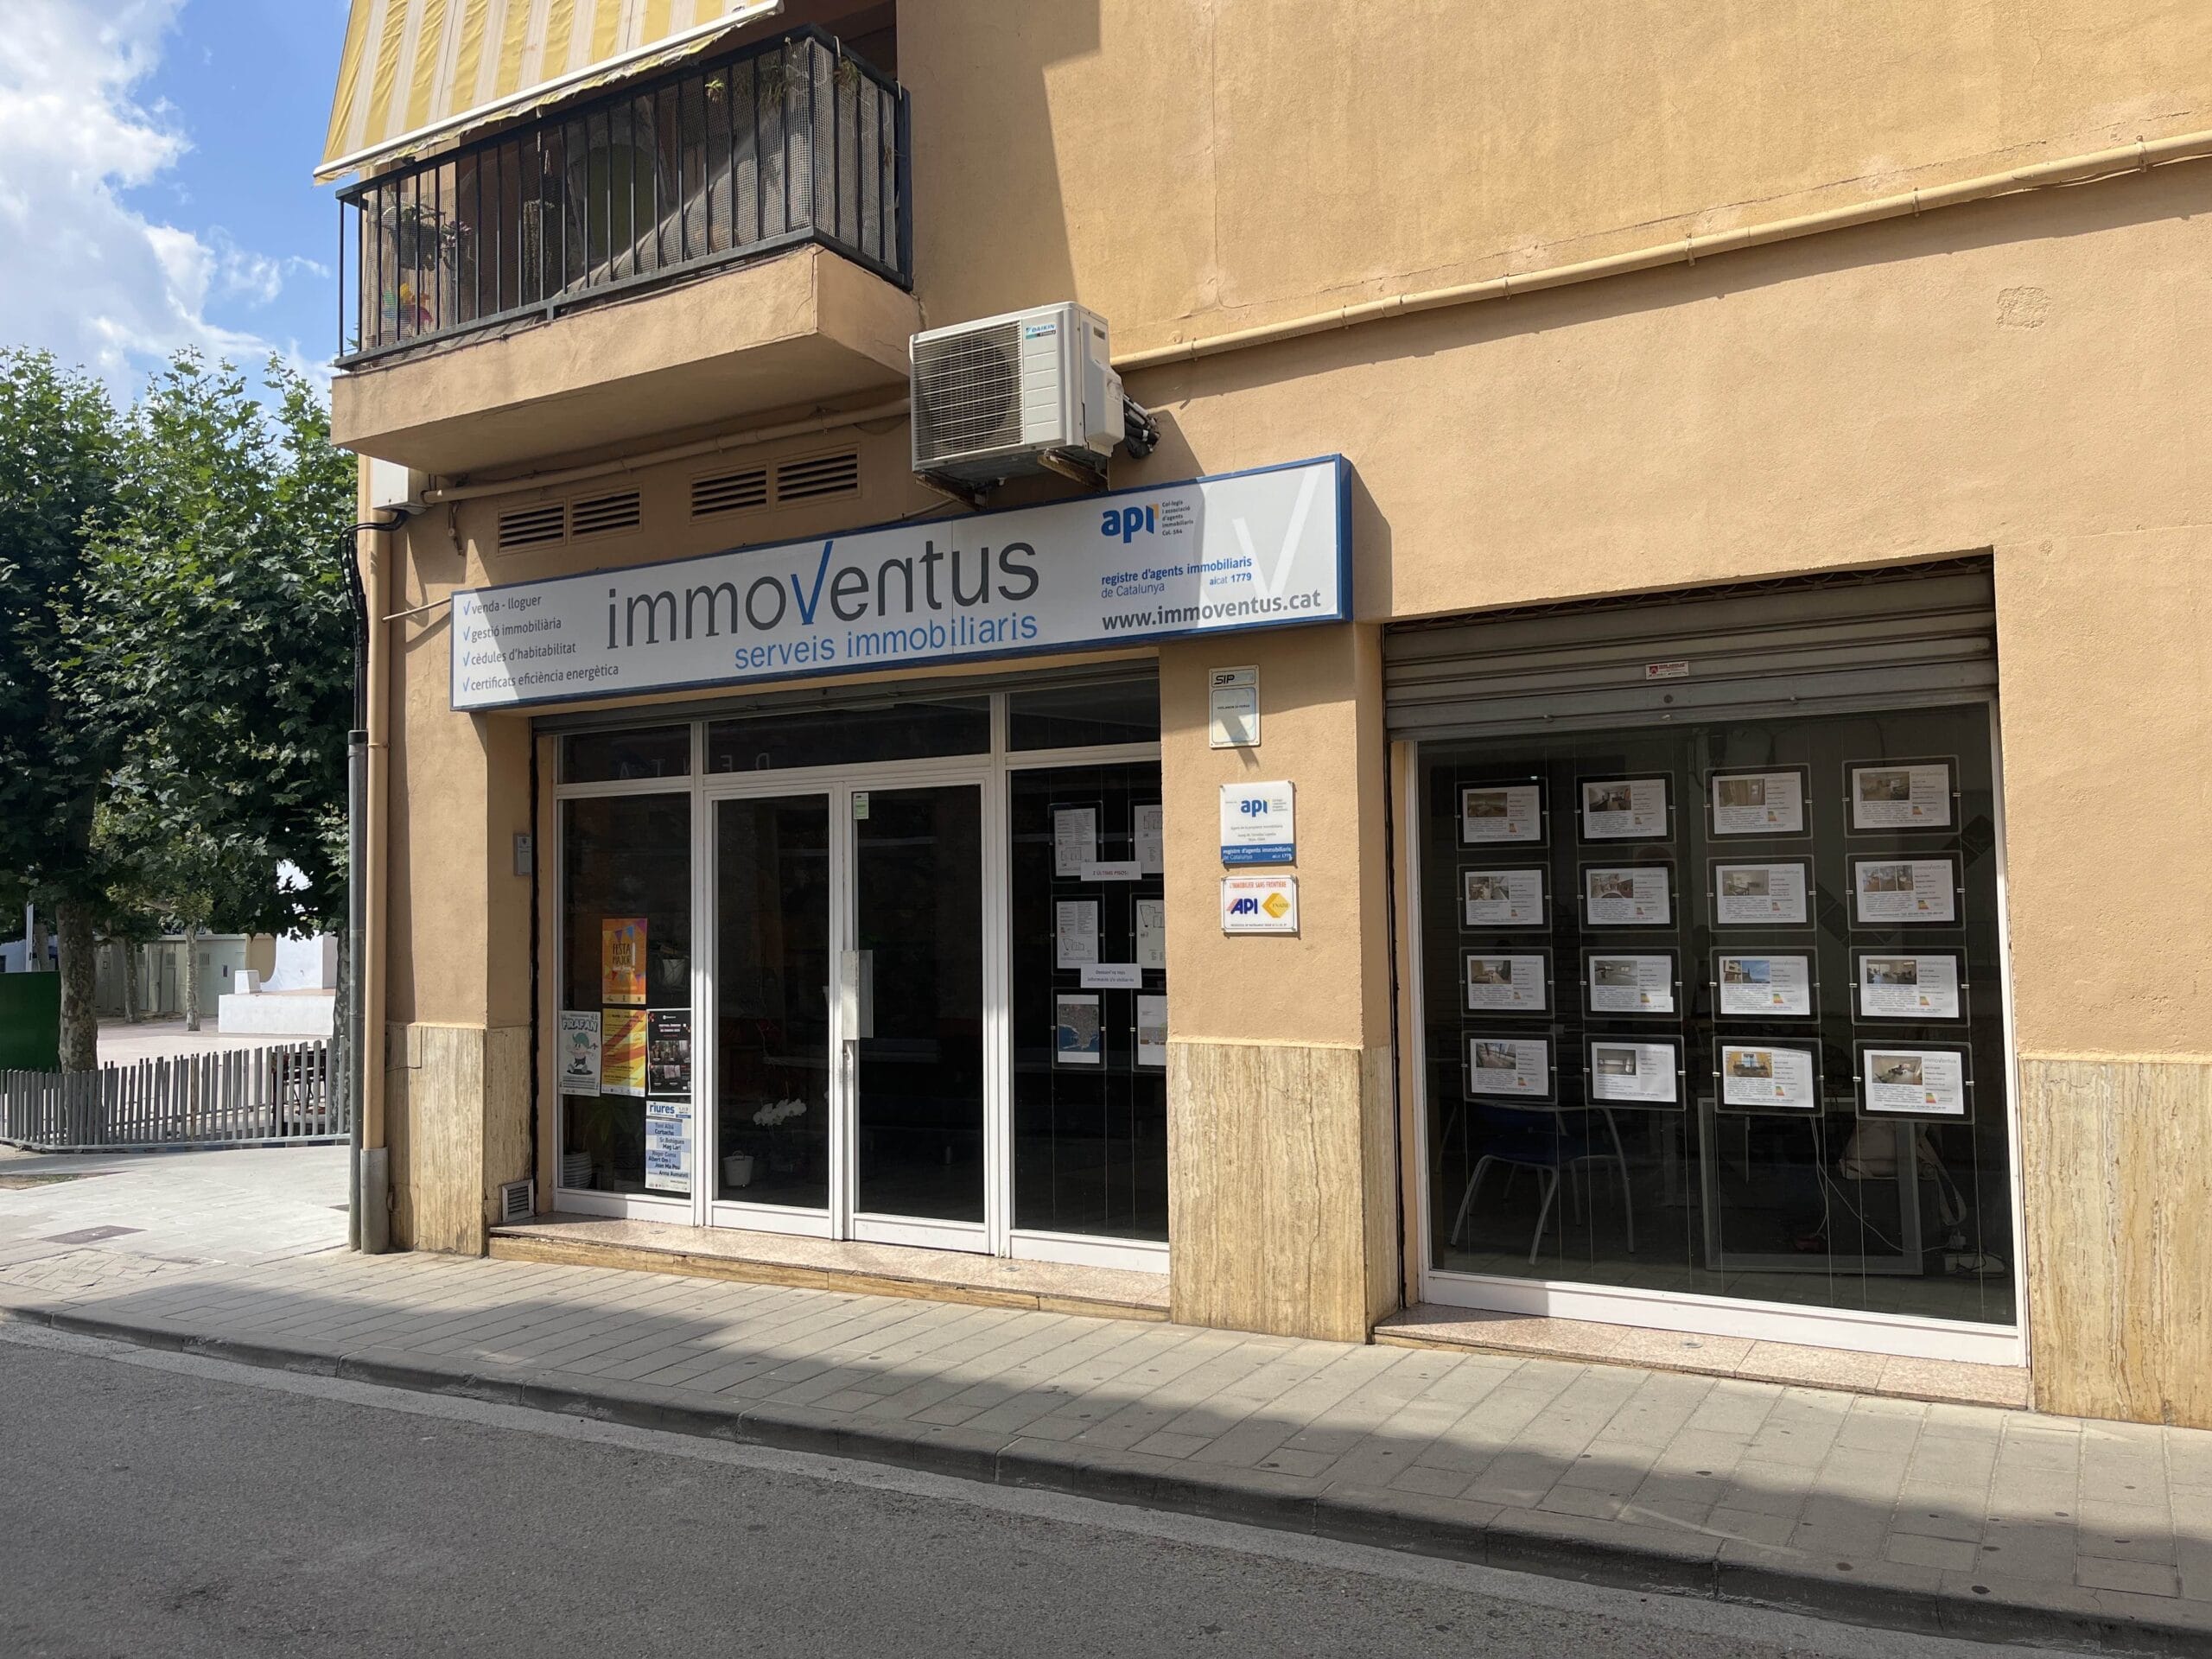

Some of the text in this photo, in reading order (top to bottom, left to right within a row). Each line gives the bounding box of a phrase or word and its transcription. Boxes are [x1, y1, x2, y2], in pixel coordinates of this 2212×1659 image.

[1100, 504, 1159, 543] api
[1162, 519, 1193, 528] immobiliaris
[1101, 556, 1253, 585] registre d'agents immobiliaris
[1209, 572, 1253, 586] aicat 1779
[1101, 582, 1166, 599] de Catalunya
[472, 601, 500, 615] venda
[507, 594, 543, 613] lloguer
[1102, 589, 1321, 631] www.immoventus.cat
[472, 617, 563, 643] gestió immobiliària
[734, 612, 1039, 671] serveis immobiliaris
[471, 642, 576, 667] cèdules d'habitabilitat
[470, 664, 620, 692] certificats eficiència energètica
[1214, 674, 1236, 685] SIP
[1241, 799, 1268, 817] api
[1230, 898, 1258, 914] API
[613, 943, 632, 955] FESTA
[650, 1102, 675, 1114] riures
